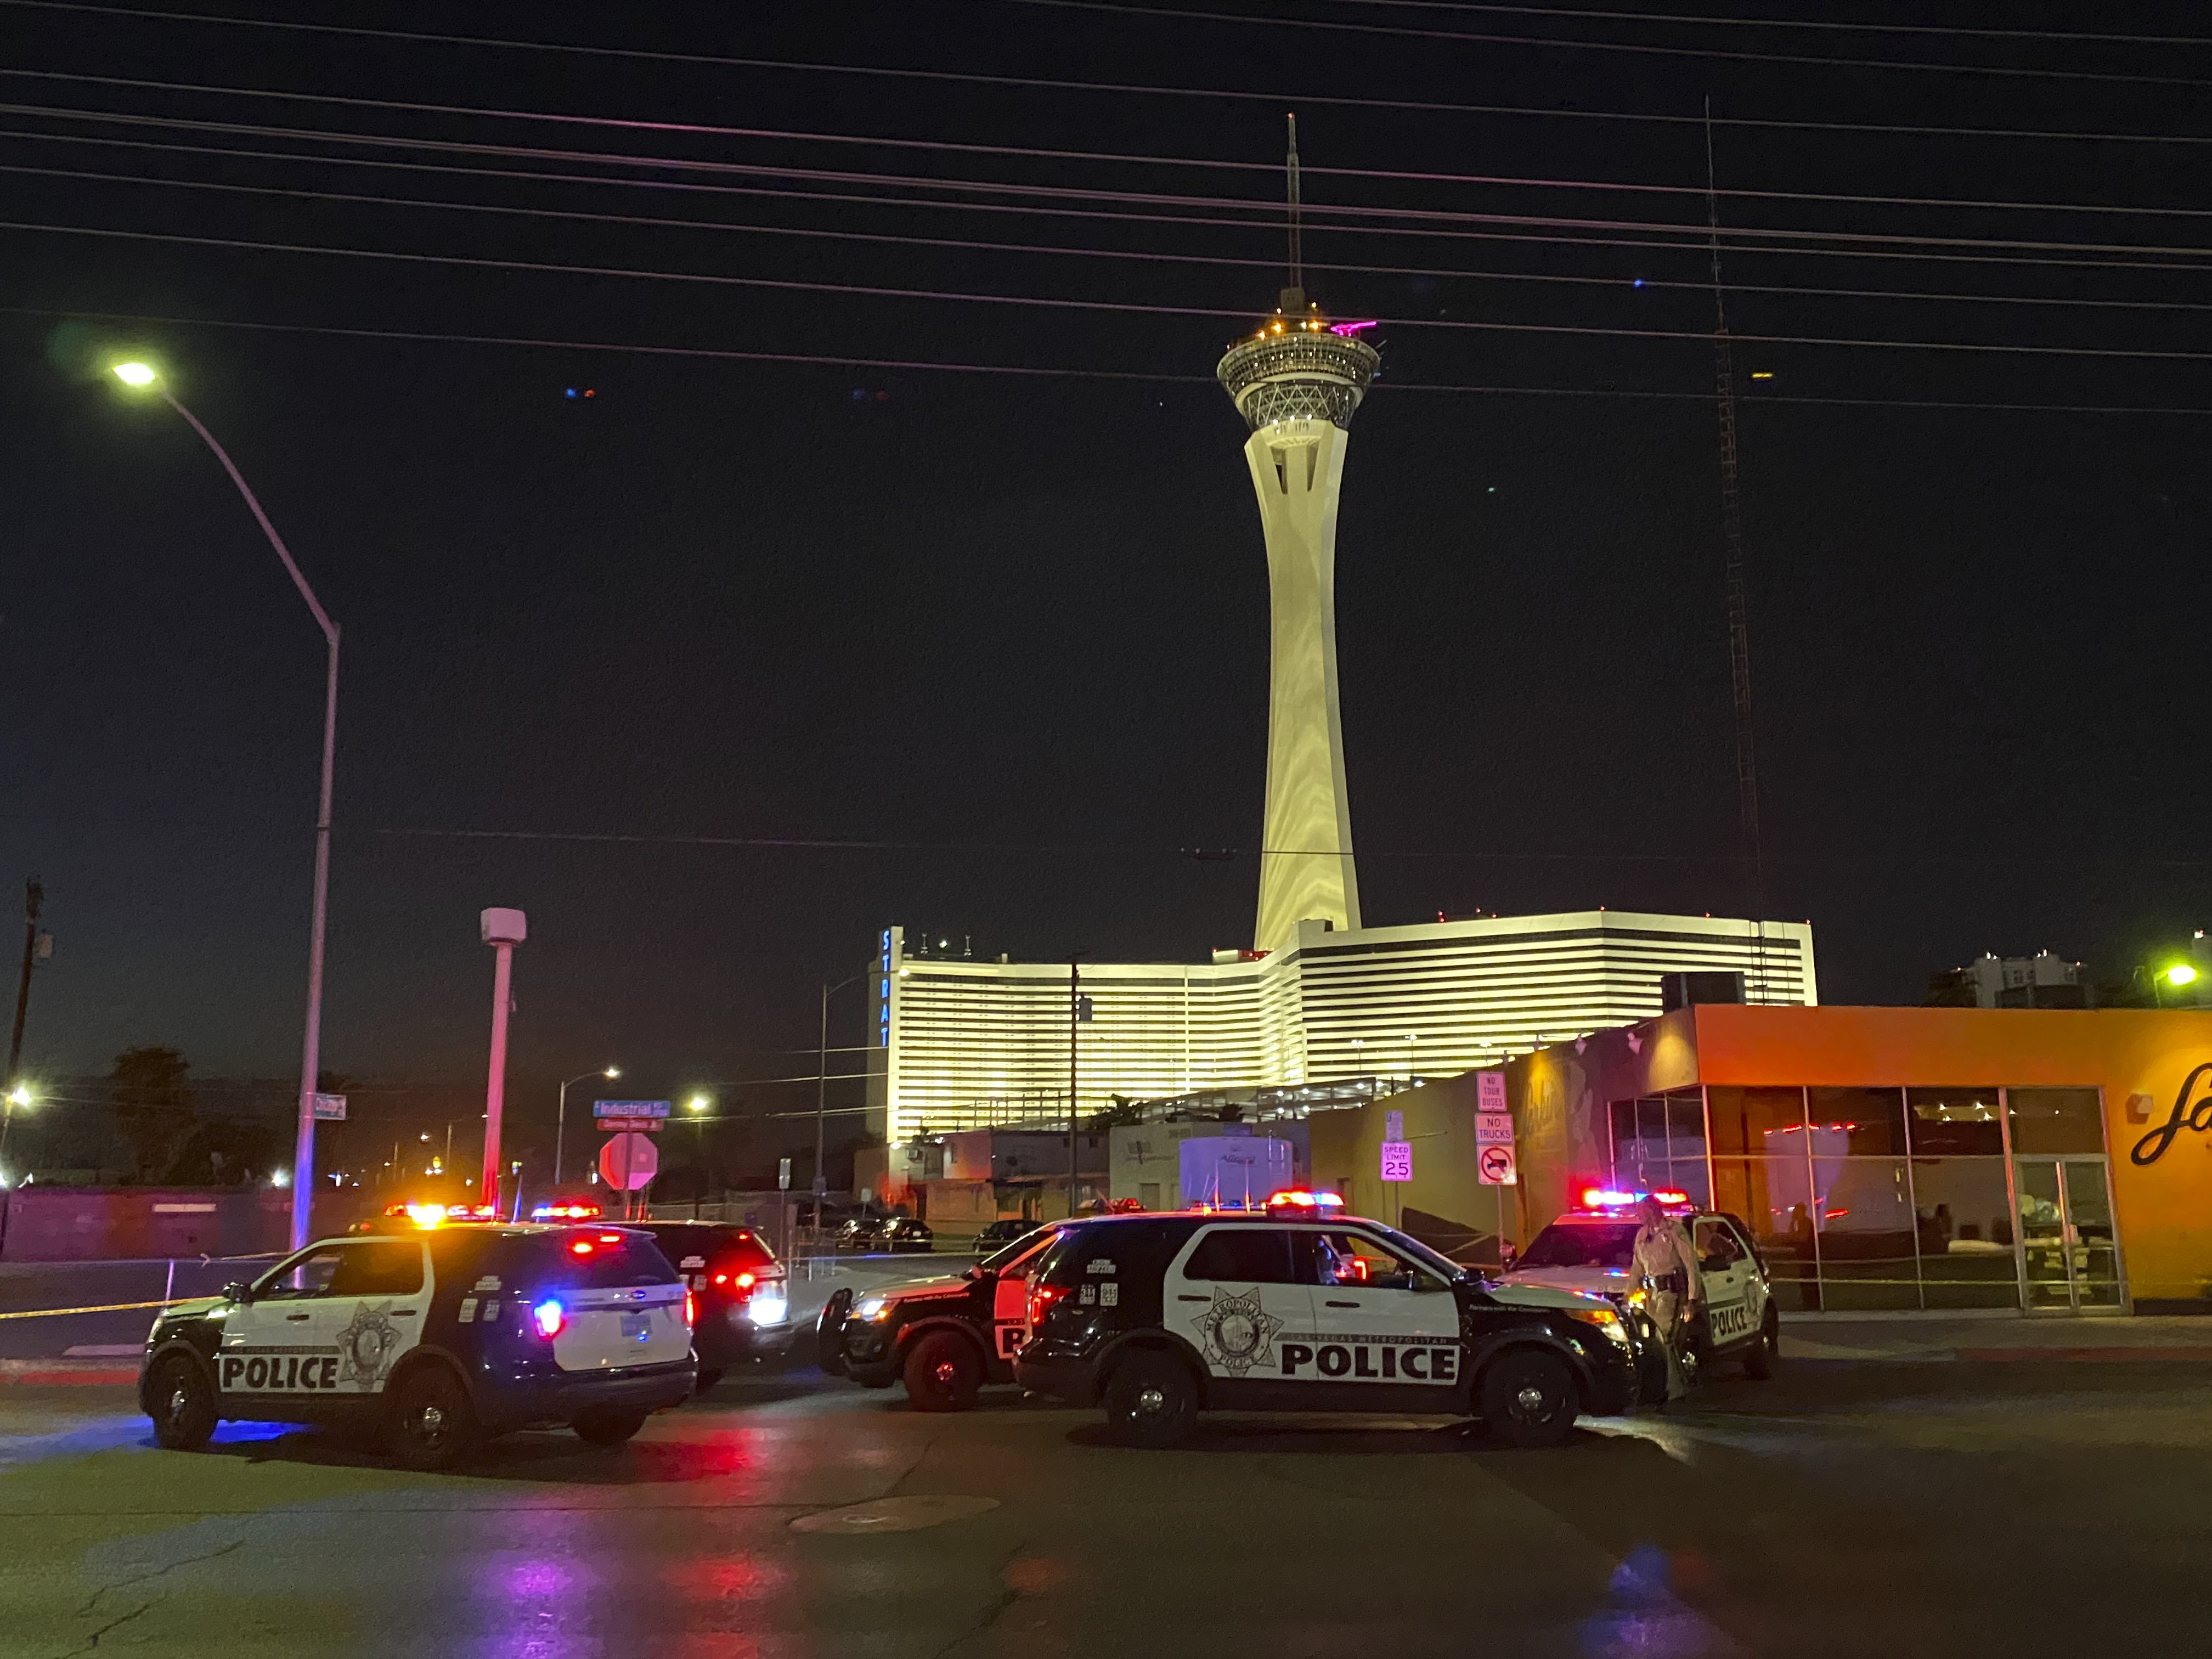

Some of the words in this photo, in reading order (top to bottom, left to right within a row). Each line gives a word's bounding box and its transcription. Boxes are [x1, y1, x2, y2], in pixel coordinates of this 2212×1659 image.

[881, 930, 890, 1047] STRAT
[1483, 1087, 1500, 1096] TOUR
[601, 1102, 651, 1115] Industrial
[1482, 1098, 1503, 1107] BUSES
[1487, 1118, 1501, 1127] NO
[1479, 1130, 1511, 1139] TRUCKS
[1385, 1162, 1408, 1176] 25
[1711, 1306, 1747, 1338] POLICE
[1358, 1335, 1447, 1345] METROPOLITAN
[1282, 1344, 1455, 1379] POLICE
[223, 1357, 338, 1389] POLICE
